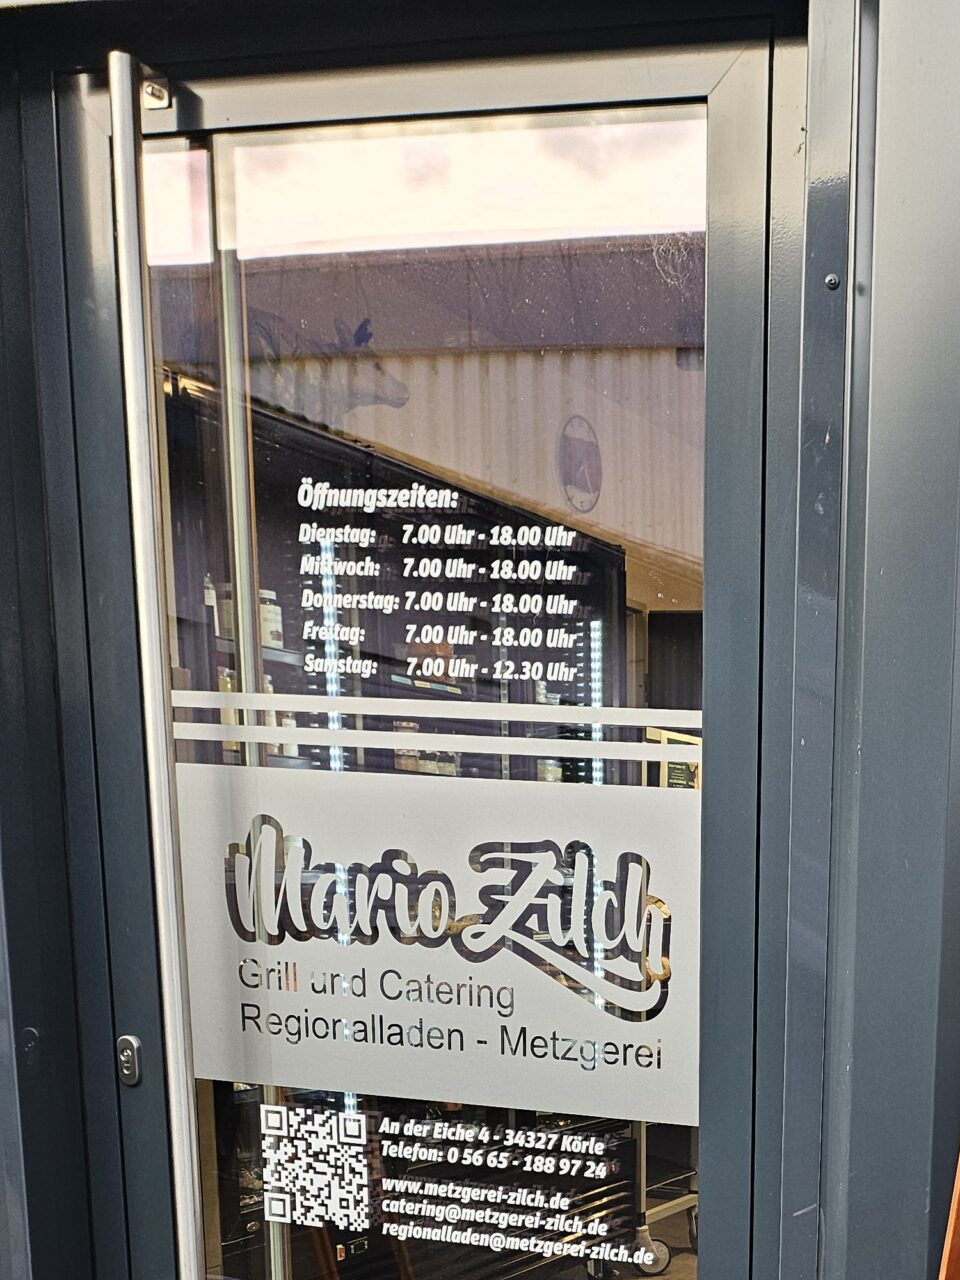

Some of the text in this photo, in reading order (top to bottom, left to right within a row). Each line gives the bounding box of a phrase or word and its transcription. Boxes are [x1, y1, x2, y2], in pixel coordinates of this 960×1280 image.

[297, 477, 459, 513] Öffnungszeiten:
[298, 523, 376, 548] Dienstag:
[402, 524, 440, 544] 7.00
[444, 525, 475, 546] Uhr
[489, 525, 541, 547] 18.00
[544, 526, 576, 548] Uhr
[299, 556, 380, 577] Mittwoch:
[402, 558, 441, 578] 7.00
[444, 558, 475, 579] Uhr
[489, 560, 541, 581] 18.00
[544, 560, 576, 581] Uhr
[301, 589, 400, 614] Donnerstag:
[404, 591, 443, 611] 7.00
[446, 591, 477, 613] Uhr
[491, 593, 542, 614] 18.00
[545, 594, 577, 615] Uhr
[302, 621, 365, 642] Freitag:
[405, 624, 443, 644] 7.00
[446, 624, 477, 646] Uhr
[491, 627, 542, 648] 18.00
[546, 627, 578, 649] Uhr
[303, 653, 377, 678] Samstag:
[406, 657, 444, 677] 7.00
[447, 658, 478, 679] Uhr
[492, 661, 543, 681] 12.30
[546, 662, 578, 682] Uhr
[227, 816, 670, 1019] Mario Zilch
[237, 957, 515, 1017] Grill und Catering
[239, 1002, 464, 1052] Regionalladen
[500, 1025, 662, 1071] Metzgerei
[379, 1117, 400, 1134] An
[403, 1119, 430, 1137] der
[433, 1122, 475, 1142] Eiche
[478, 1128, 490, 1144] 4
[503, 1129, 557, 1150] 34327
[560, 1135, 605, 1155] Körle
[381, 1140, 443, 1163] Telefon:
[447, 1147, 459, 1164] 0
[461, 1148, 483, 1166] 56
[486, 1150, 509, 1168] 65
[522, 1155, 555, 1173] 188
[558, 1159, 583, 1176] 97
[584, 1161, 607, 1179] 24
[381, 1177, 570, 1210] www.metzgerei-zilch.de
[381, 1198, 608, 1236] catering@metzgerei-zilch.de
[381, 1221, 653, 1265] regionalladen@metzgerei-zilch.de
